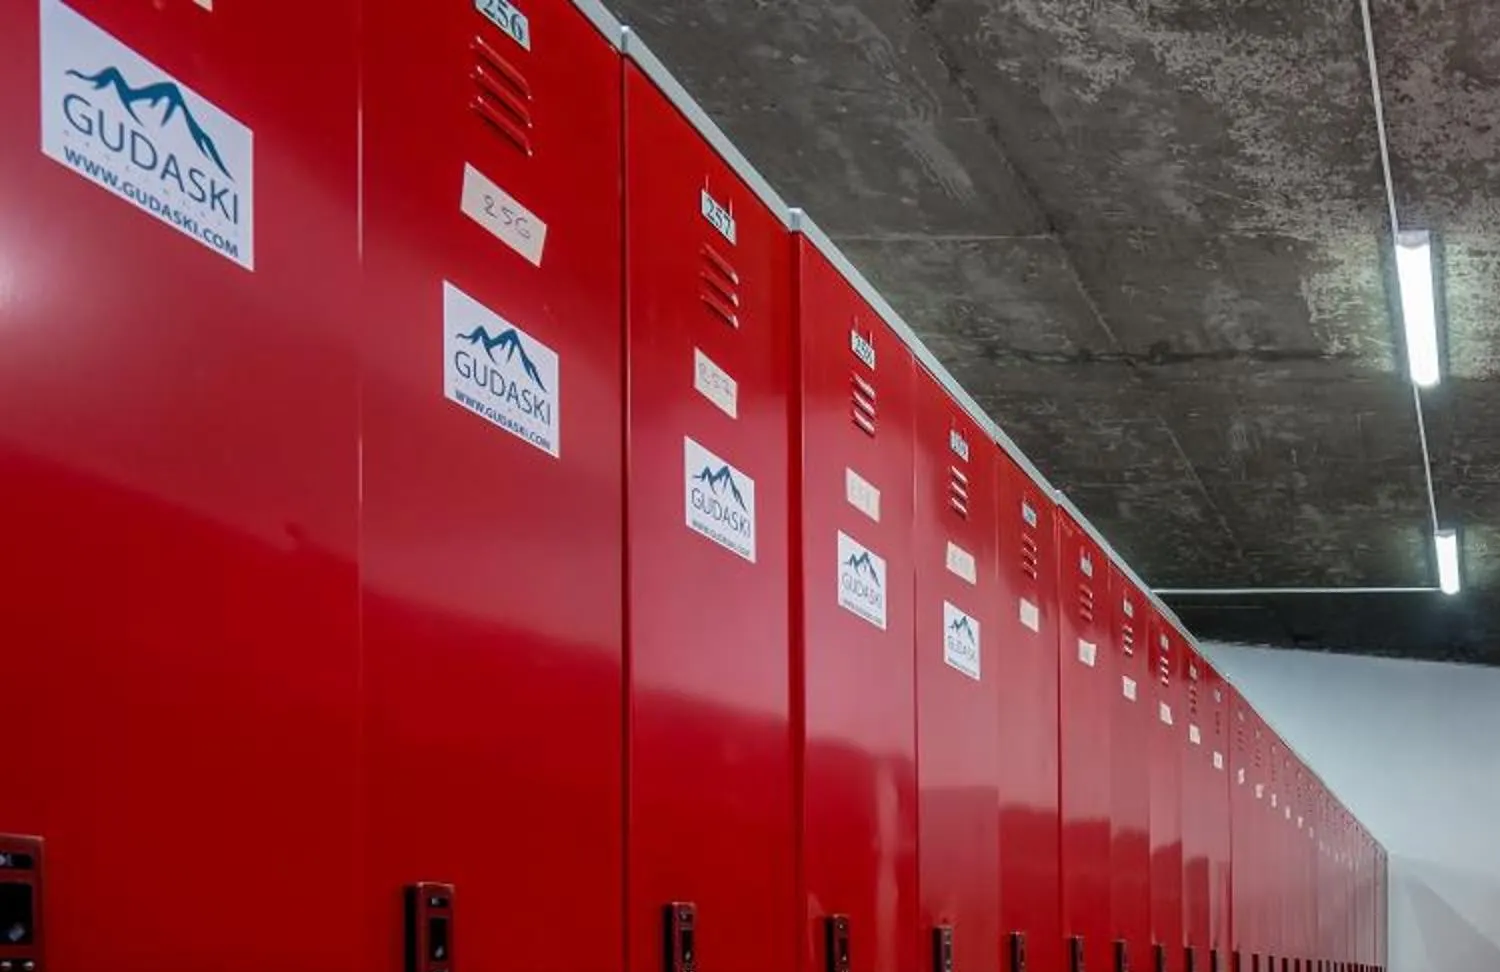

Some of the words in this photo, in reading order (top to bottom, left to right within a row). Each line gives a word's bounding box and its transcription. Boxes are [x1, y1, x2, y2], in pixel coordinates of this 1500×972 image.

[63, 93, 239, 225] GUDASKI
[63, 145, 239, 258] WWW.GUDASKI.COM
[707, 197, 731, 236] 257
[455, 350, 551, 426] GUDASKI
[691, 487, 752, 539] GUDASKI
